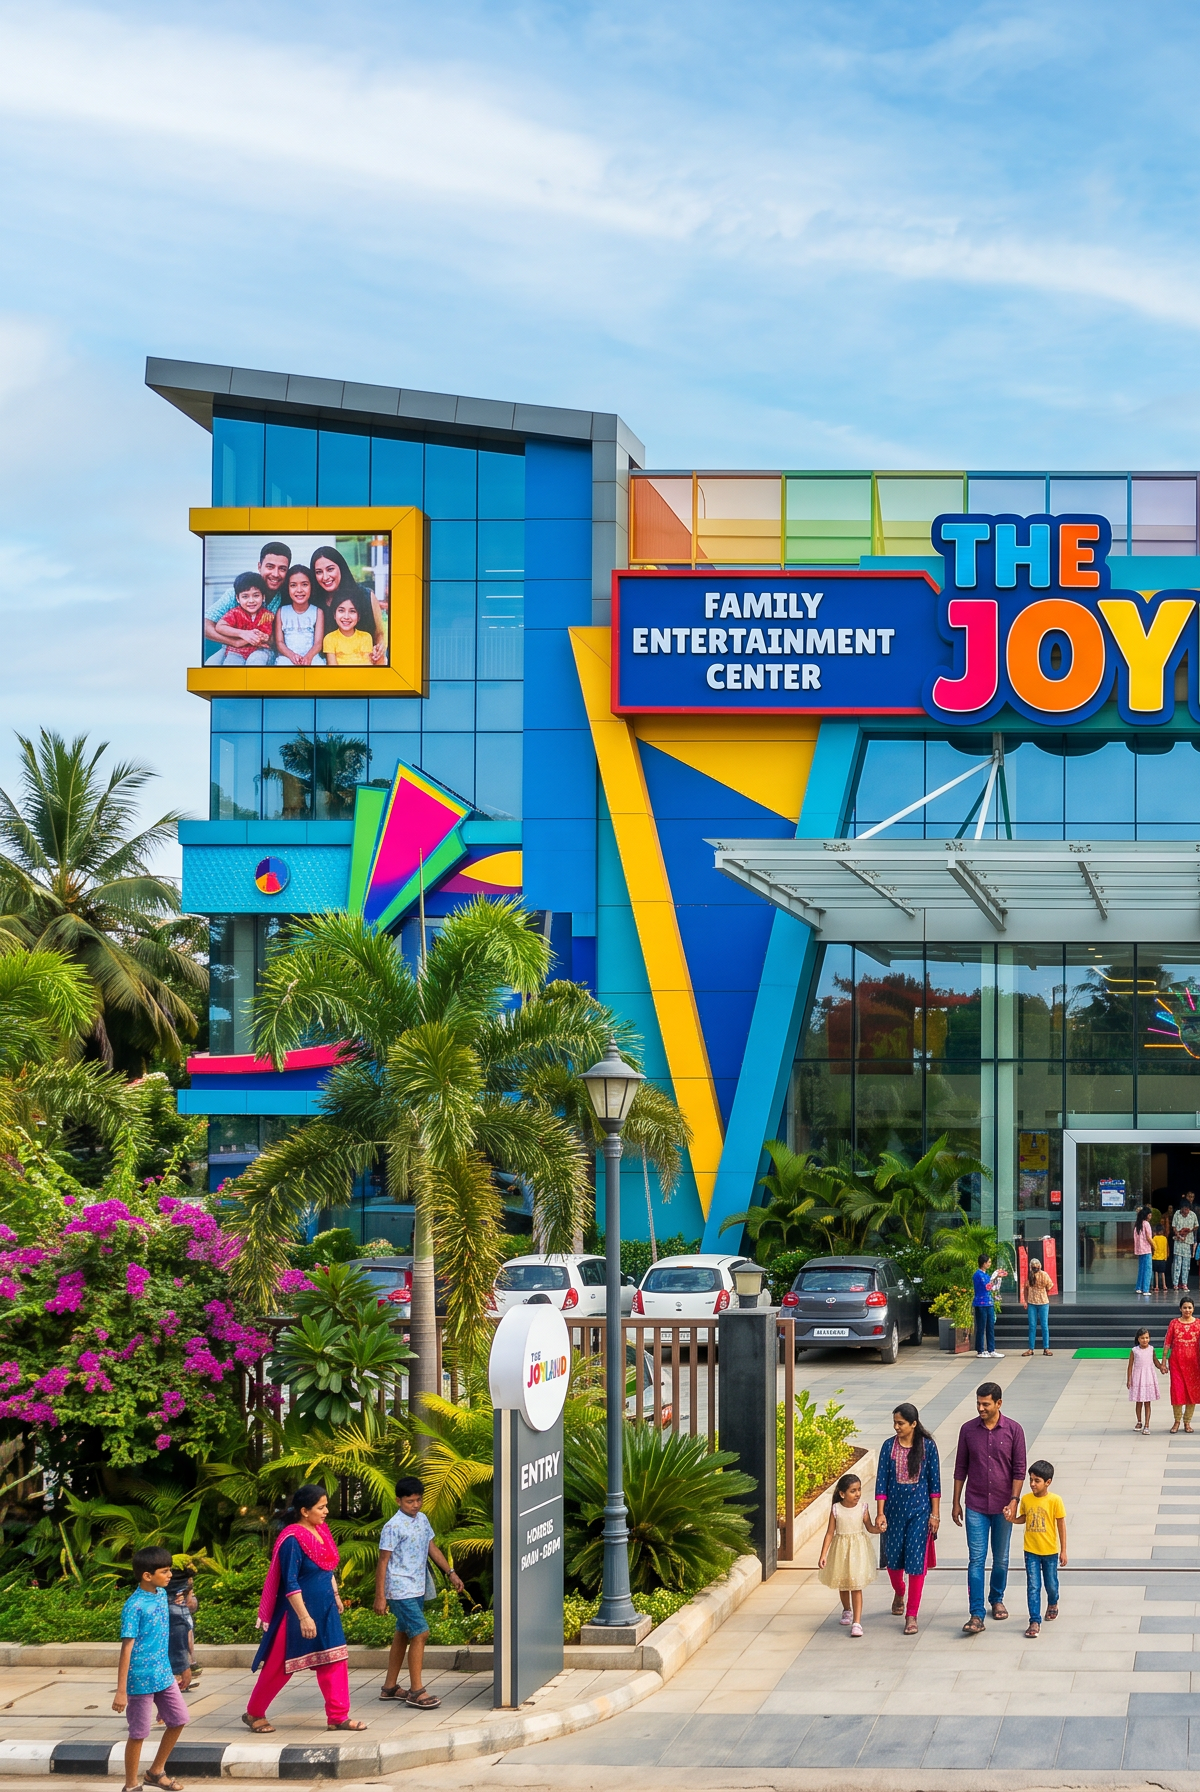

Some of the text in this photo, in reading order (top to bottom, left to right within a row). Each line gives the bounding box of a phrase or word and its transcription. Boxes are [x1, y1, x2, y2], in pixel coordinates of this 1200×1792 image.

[941, 523, 1101, 589] THE
[705, 592, 824, 620] FAMILY
[632, 627, 896, 656] ENTERTAINMENT
[706, 663, 823, 691] CENTER
[527, 1355, 567, 1388] JOYLAND
[521, 1450, 561, 1491] ENTRY
